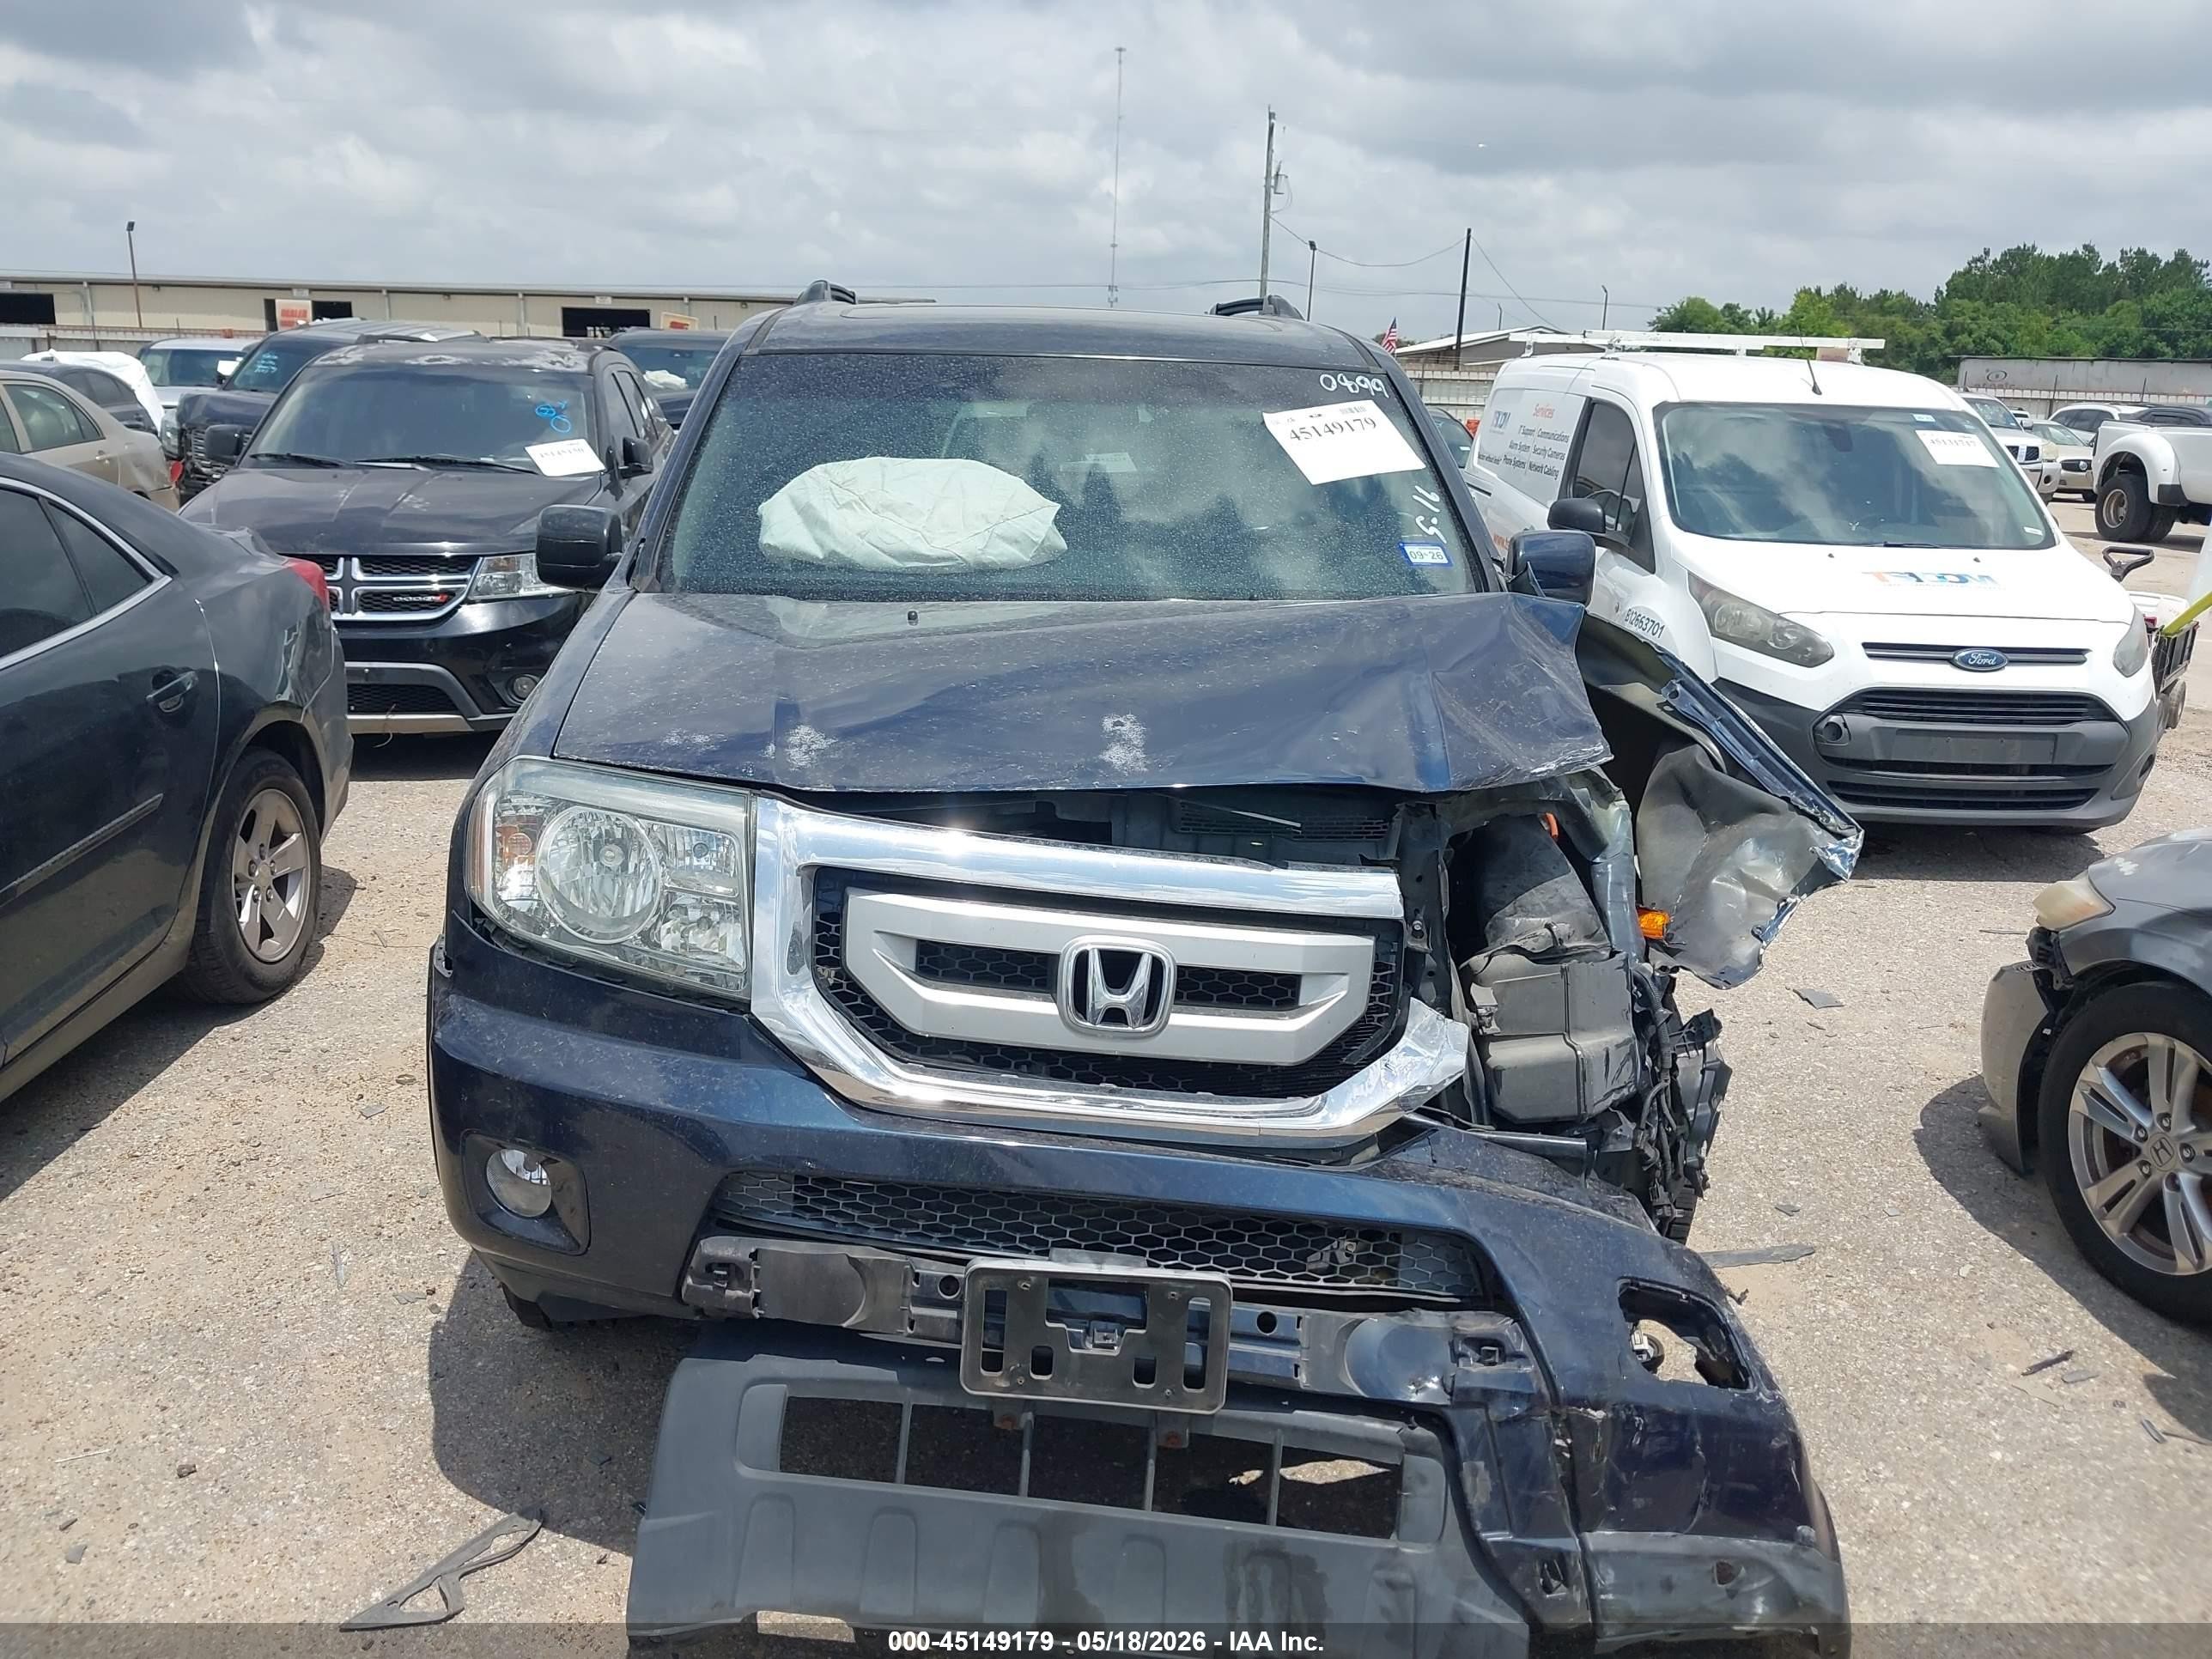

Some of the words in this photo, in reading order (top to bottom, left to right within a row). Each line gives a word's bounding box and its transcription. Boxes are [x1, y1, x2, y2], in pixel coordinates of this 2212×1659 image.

[1320, 373, 1389, 398] 0899
[1290, 416, 1376, 441] 45149179
[1968, 652, 1997, 666] Ford
